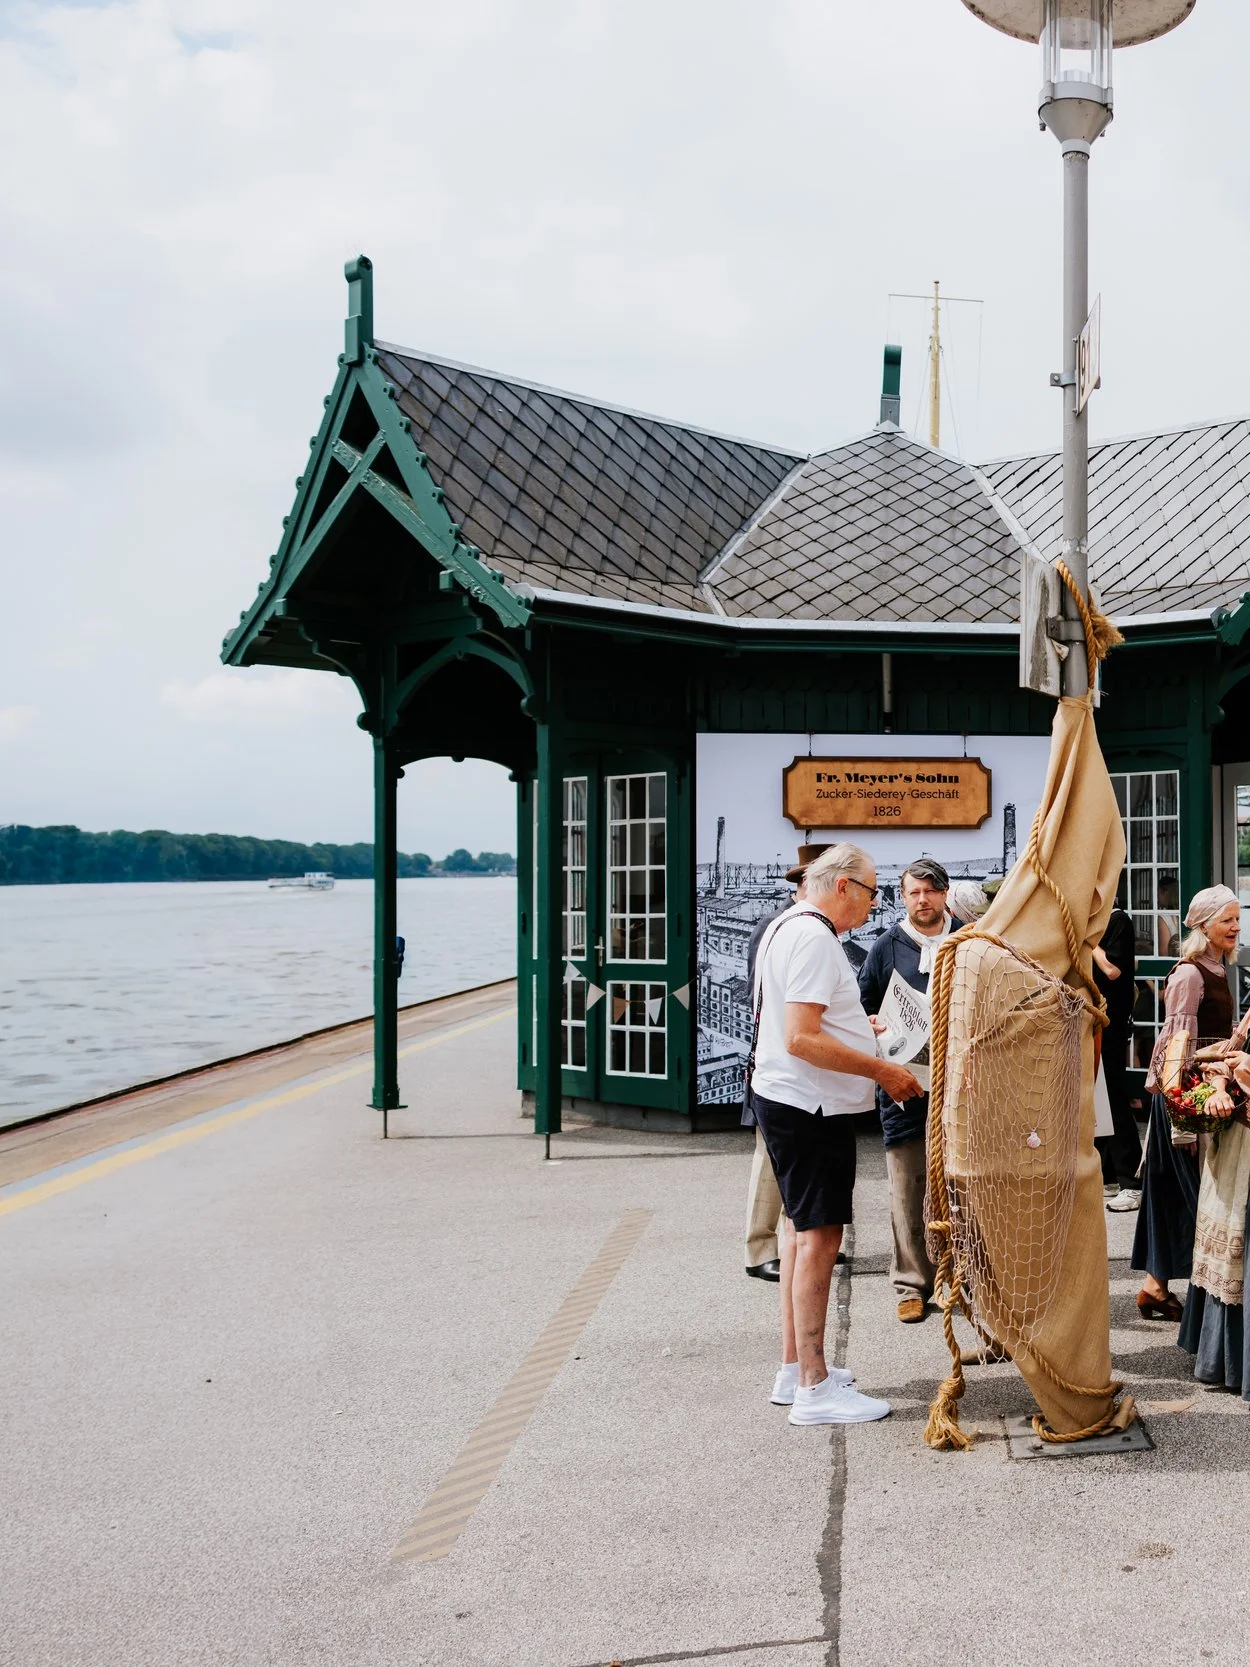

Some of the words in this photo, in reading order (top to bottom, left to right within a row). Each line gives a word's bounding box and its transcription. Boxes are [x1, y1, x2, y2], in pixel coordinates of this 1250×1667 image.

[816, 772, 841, 783] Fr.
[844, 772, 913, 786] Meyer's
[915, 772, 959, 784] Sohn
[816, 788, 960, 801] Zucker-Siederey-Geschäft
[873, 805, 902, 817] 1826
[900, 1007, 915, 1031] 1826
